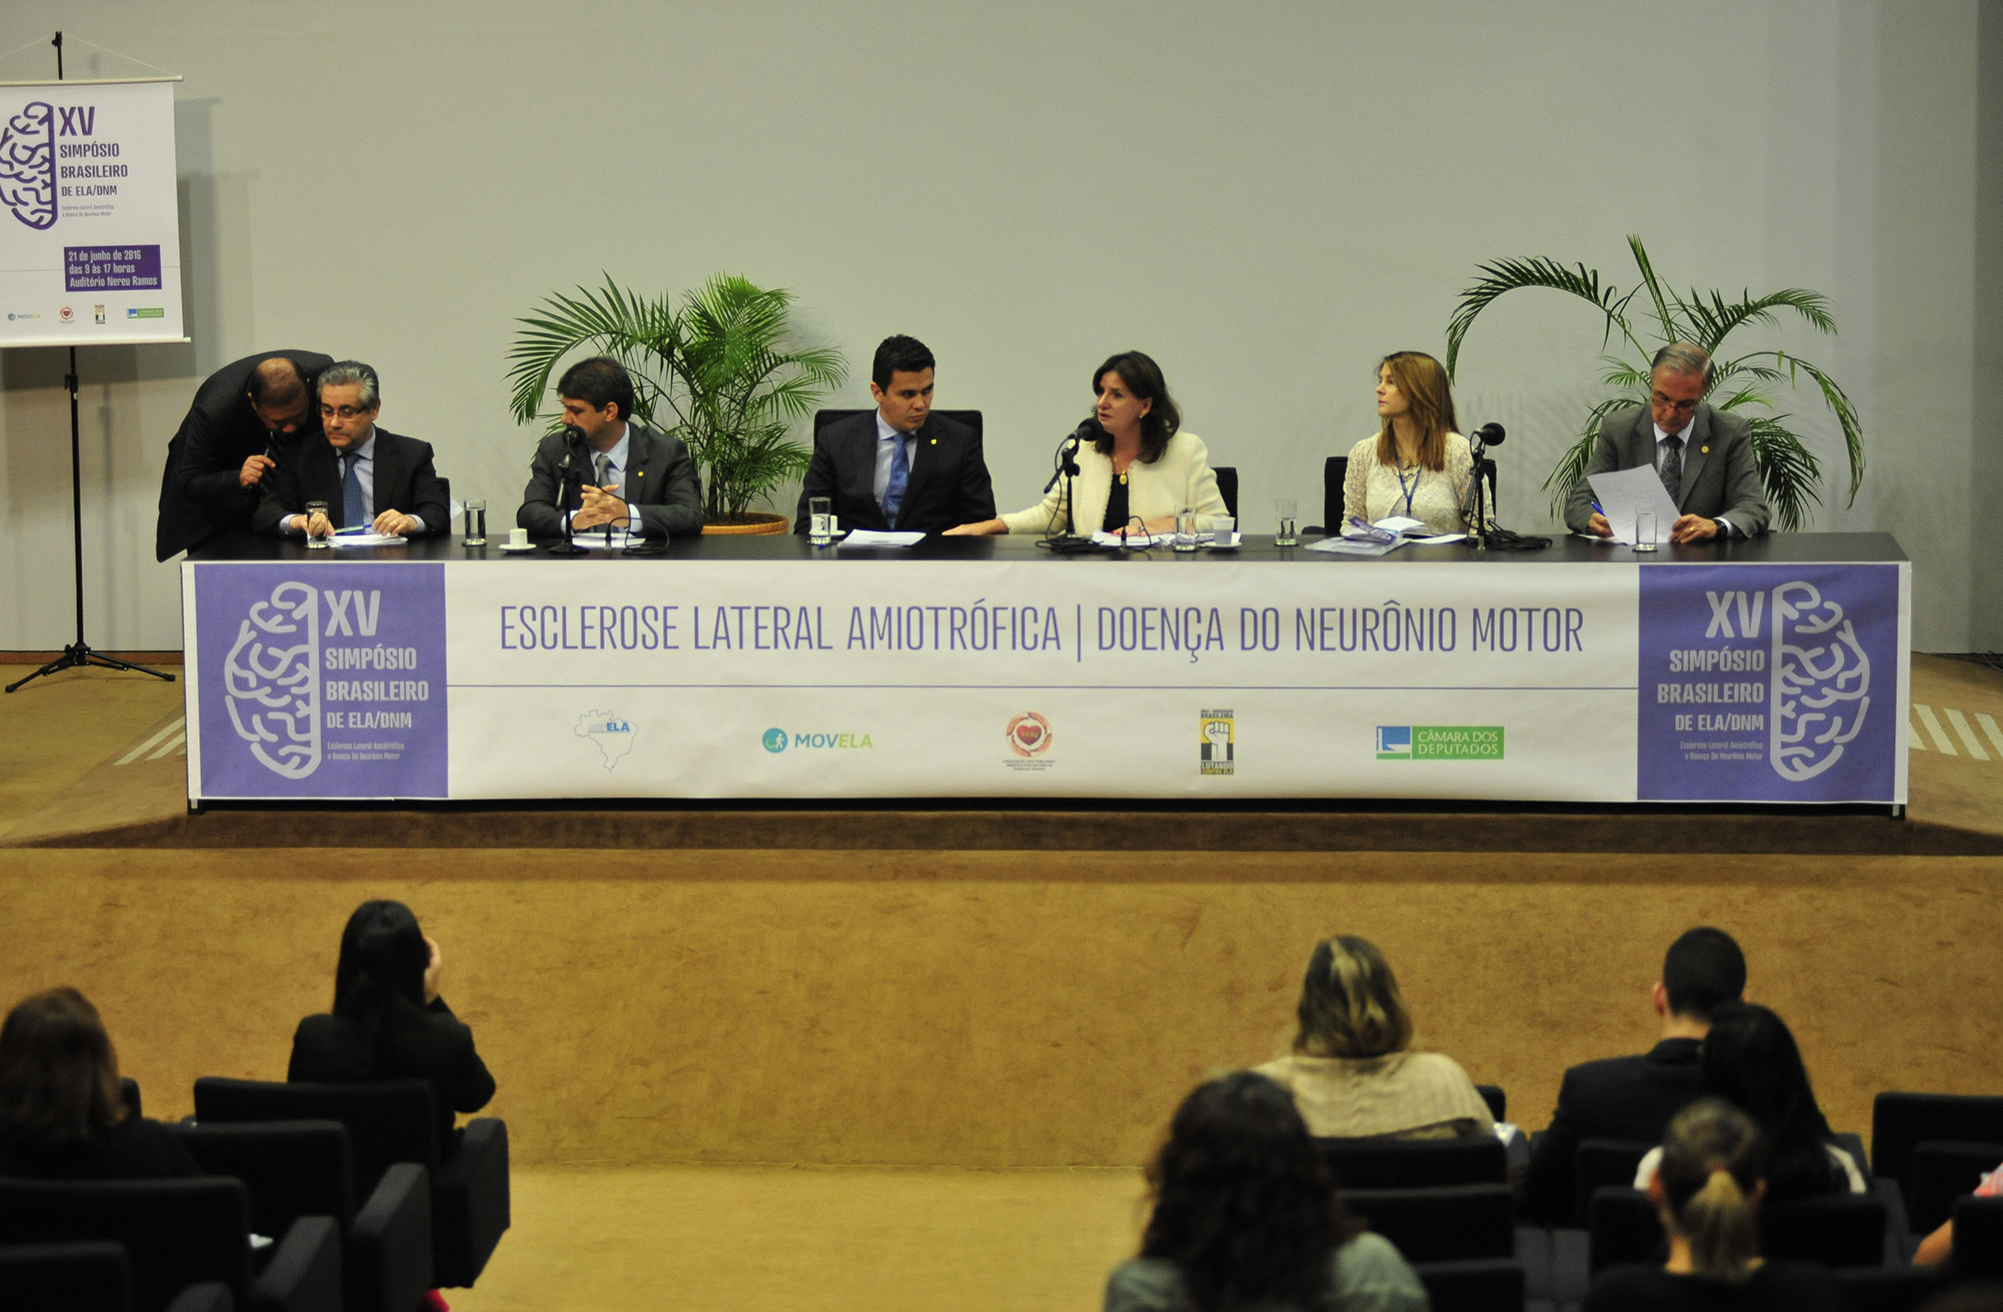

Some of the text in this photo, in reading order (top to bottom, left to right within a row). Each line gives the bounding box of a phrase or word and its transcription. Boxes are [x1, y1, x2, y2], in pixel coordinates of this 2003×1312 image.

[59, 106, 95, 136] XV
[60, 141, 120, 158] SIMPÓSIO
[61, 165, 128, 179] BRASILEIRO
[62, 184, 117, 196] DE ELA/DNM
[69, 250, 141, 263] 21 de junho de 2016
[69, 263, 135, 274] das 9 às 17 horas
[70, 276, 157, 288] Auditório Nereu Ramos
[324, 590, 381, 636] XV
[1705, 591, 1765, 638] XV
[500, 598, 1584, 663] ESCLEROSE LATERAL AMIOTRÓFICA DOENÇA DO NEURÔNIO MOTOR
[325, 643, 417, 670] SIMPÓSIO
[1669, 645, 1765, 672] SIMPÓSIO
[326, 681, 429, 701] BRASILEIRO
[1657, 683, 1764, 703] BRASILEIRO
[327, 711, 412, 729] DE ELA/DNM
[1675, 713, 1764, 731] DE ELA/DNM
[794, 734, 872, 748] MOVELA
[1418, 729, 1498, 742] CÂMARA DOS
[1418, 744, 1498, 754] DEPUTADOS
